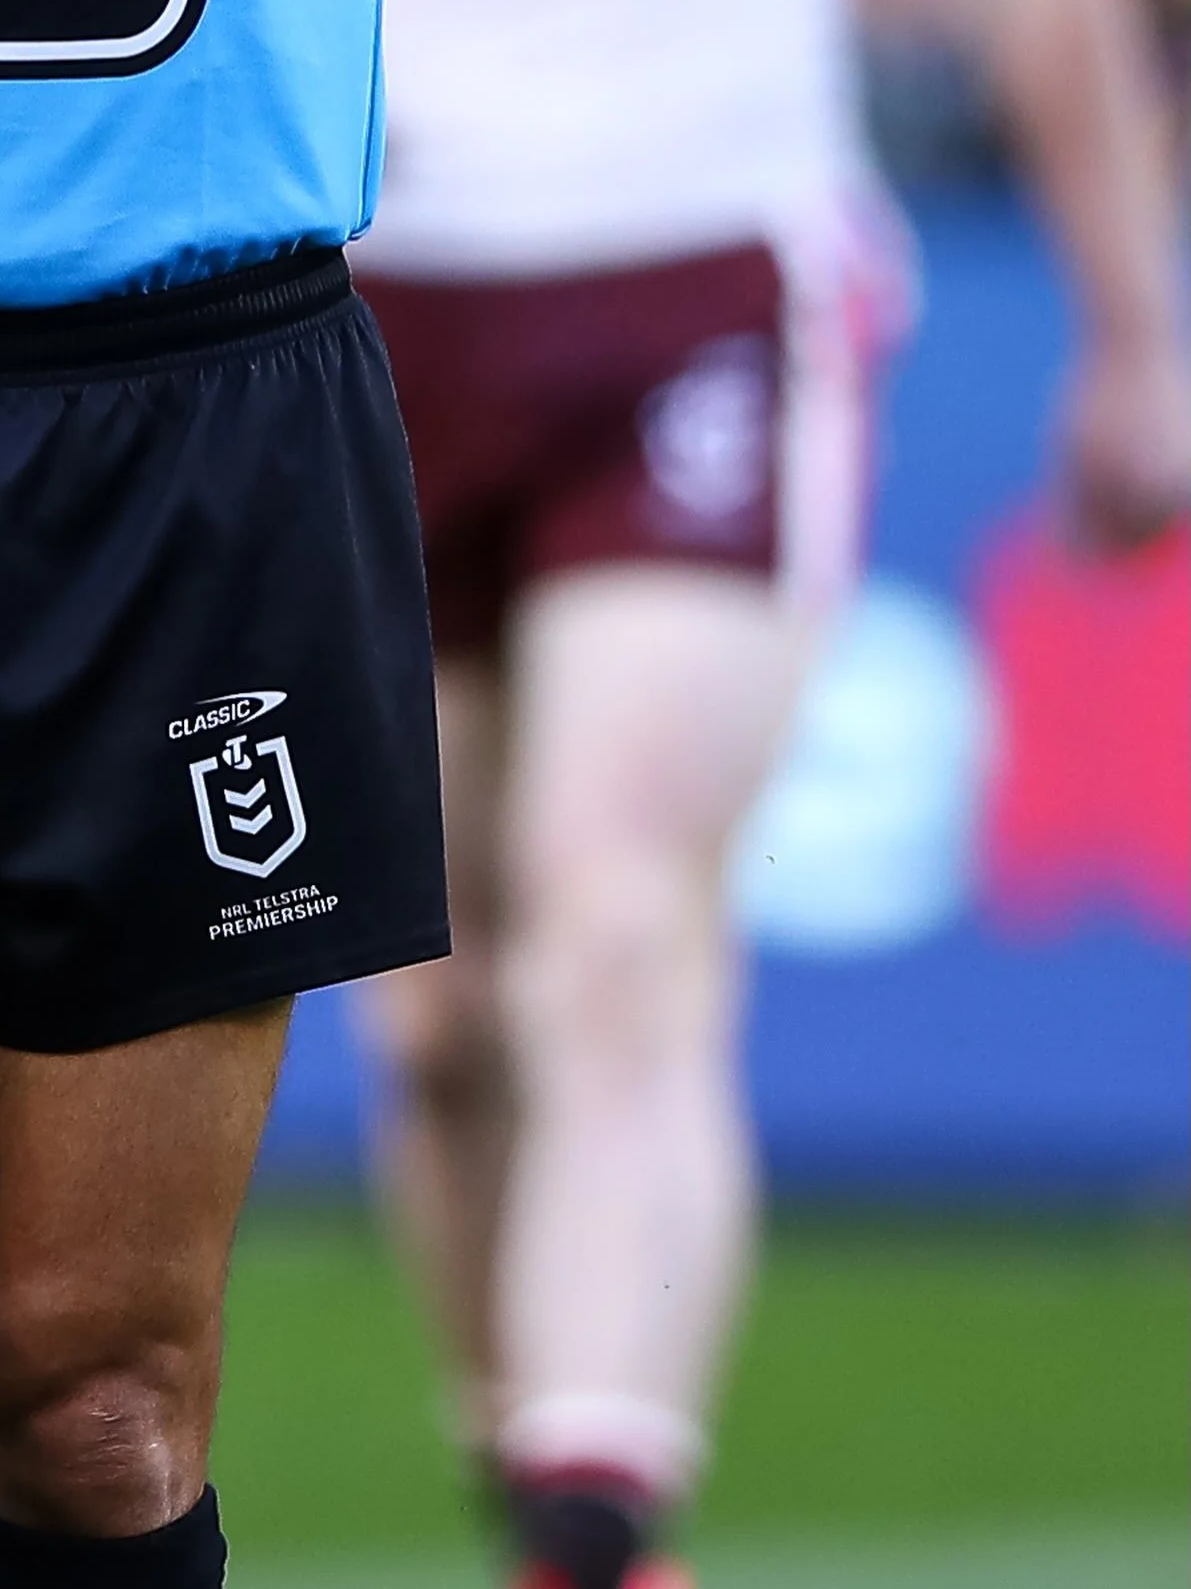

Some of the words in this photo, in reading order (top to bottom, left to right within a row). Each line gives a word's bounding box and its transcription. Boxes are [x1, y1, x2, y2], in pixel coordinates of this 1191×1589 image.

[168, 699, 251, 739] CLASSIC
[209, 895, 339, 940] PREMIERSHIP
[221, 901, 251, 919] NRL
[253, 884, 320, 912] TELSTRA
